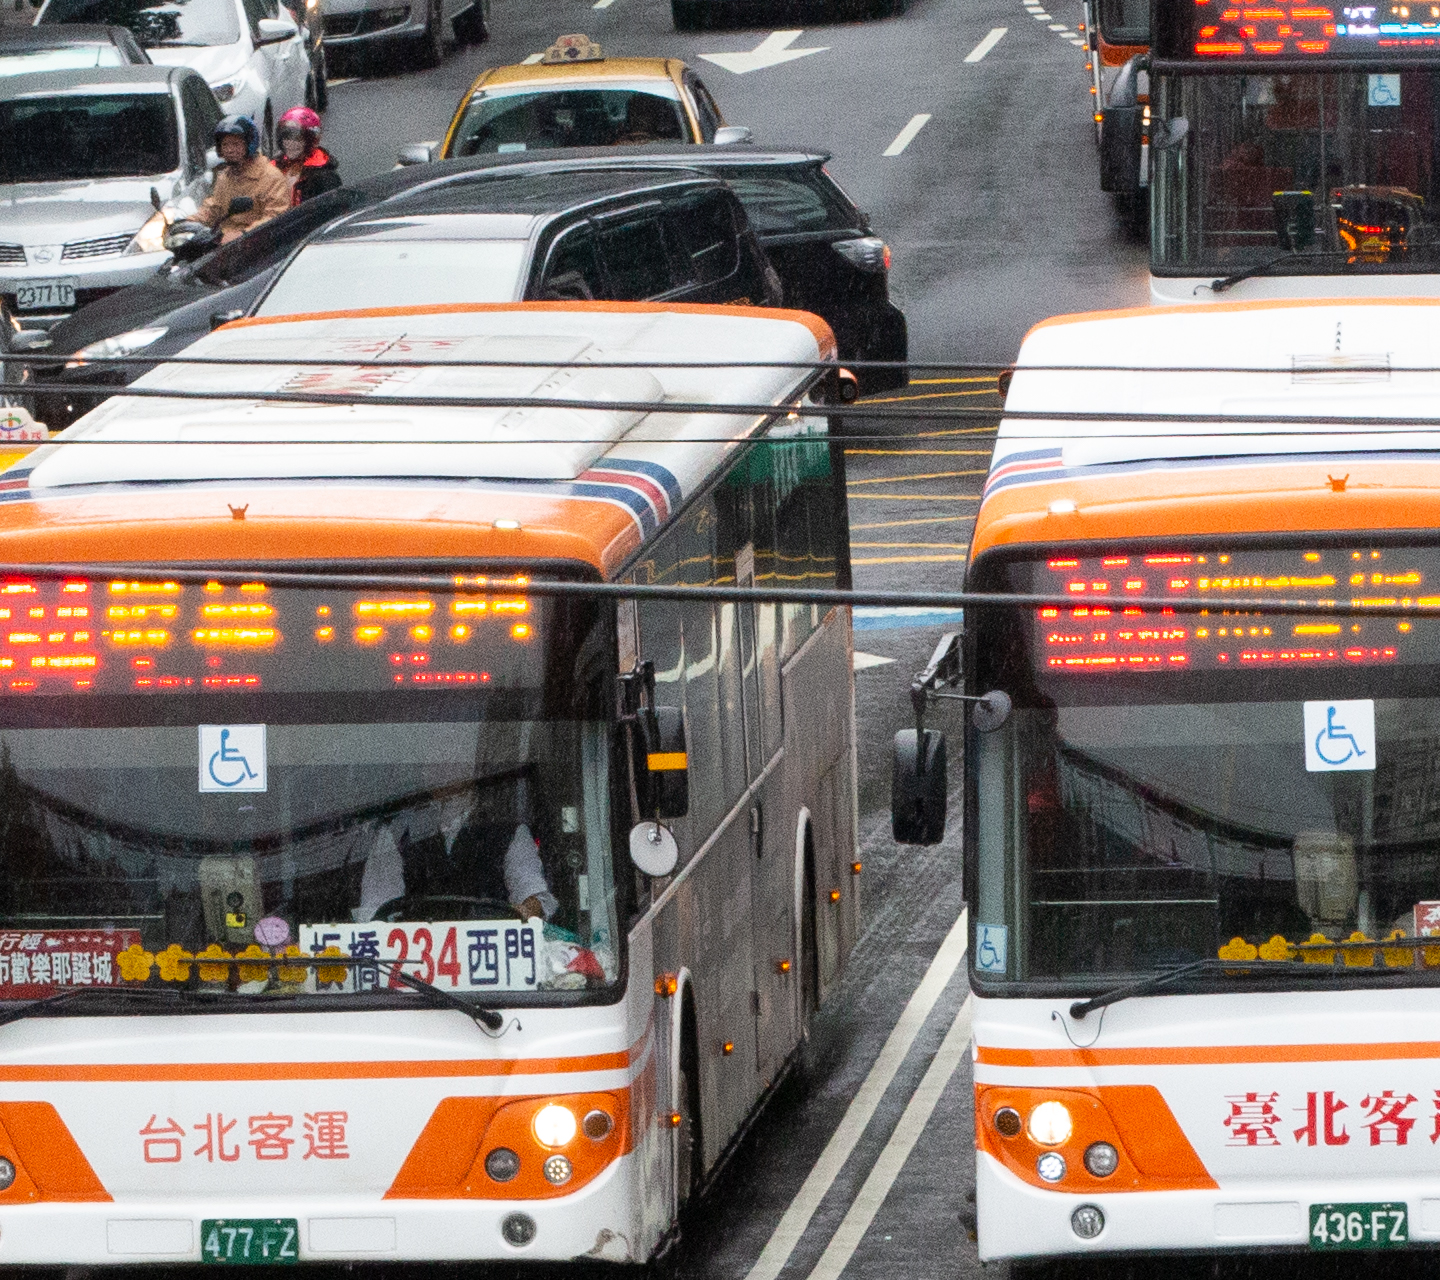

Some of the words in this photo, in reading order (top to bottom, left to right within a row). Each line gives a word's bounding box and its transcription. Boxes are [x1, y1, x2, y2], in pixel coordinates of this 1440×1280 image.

[387, 926, 462, 989] 234
[466, 928, 536, 986] 西門
[139, 1111, 350, 1163] 台北客運
[204, 1226, 296, 1257] 477-FZ
[1312, 1210, 1406, 1243] 436-FZ
